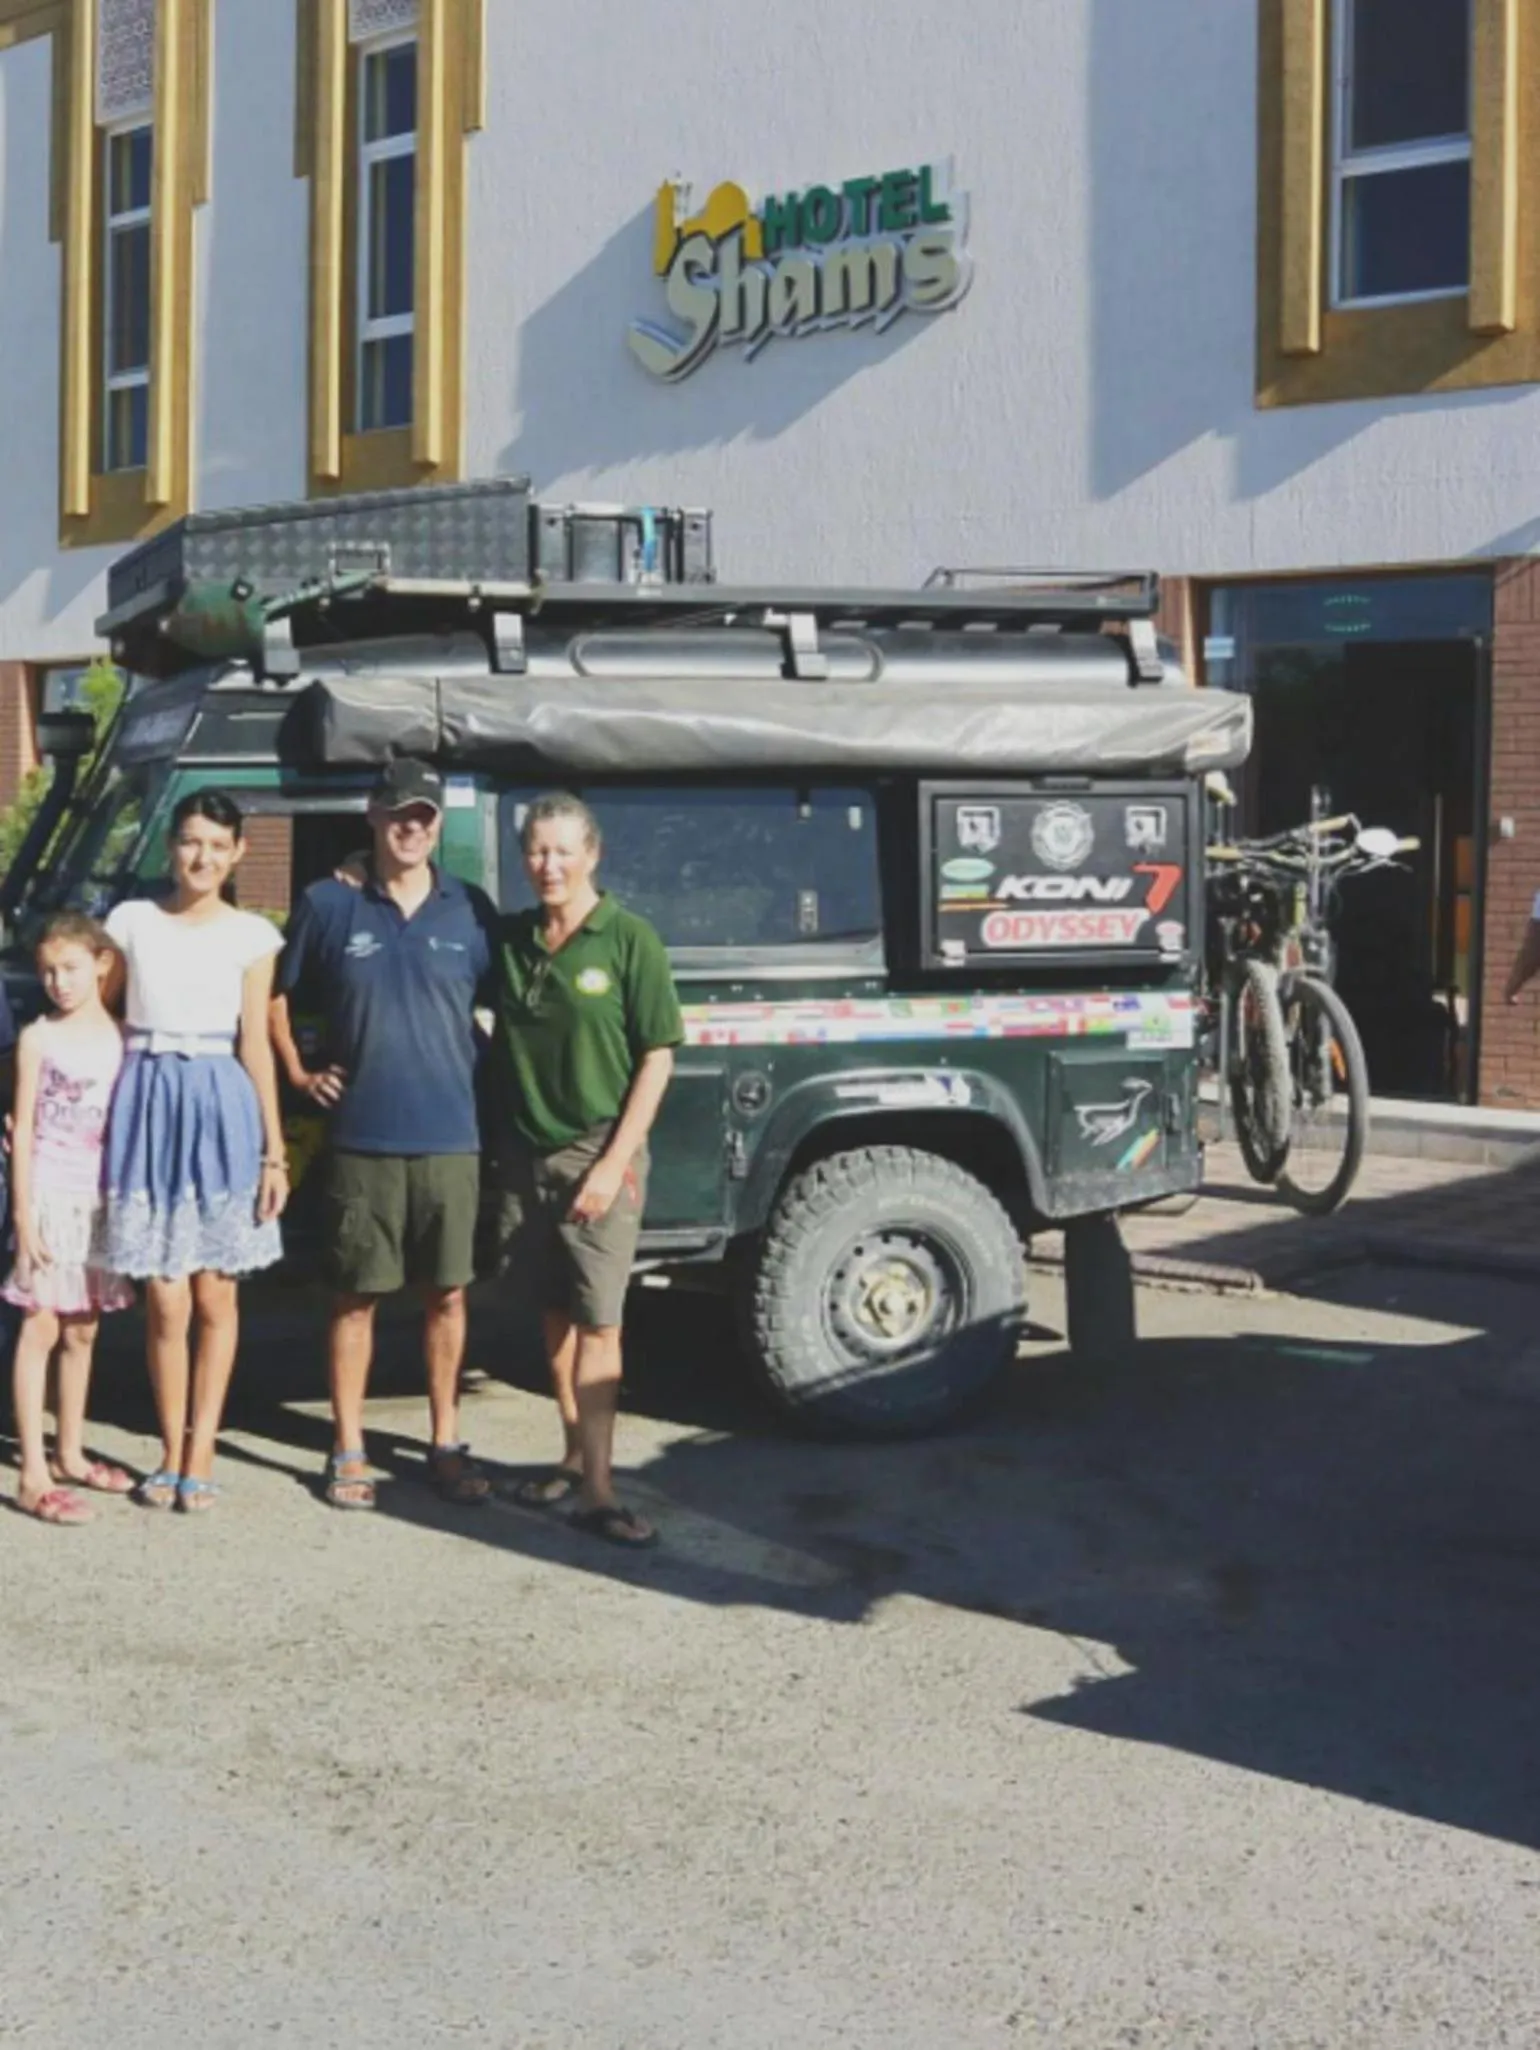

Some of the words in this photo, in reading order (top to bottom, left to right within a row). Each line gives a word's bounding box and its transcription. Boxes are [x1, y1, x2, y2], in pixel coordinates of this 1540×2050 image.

[764, 165, 950, 249] HOTEL
[628, 230, 962, 378] Shams
[995, 876, 1132, 900] KONI
[987, 914, 1138, 941] ODYSSEY
